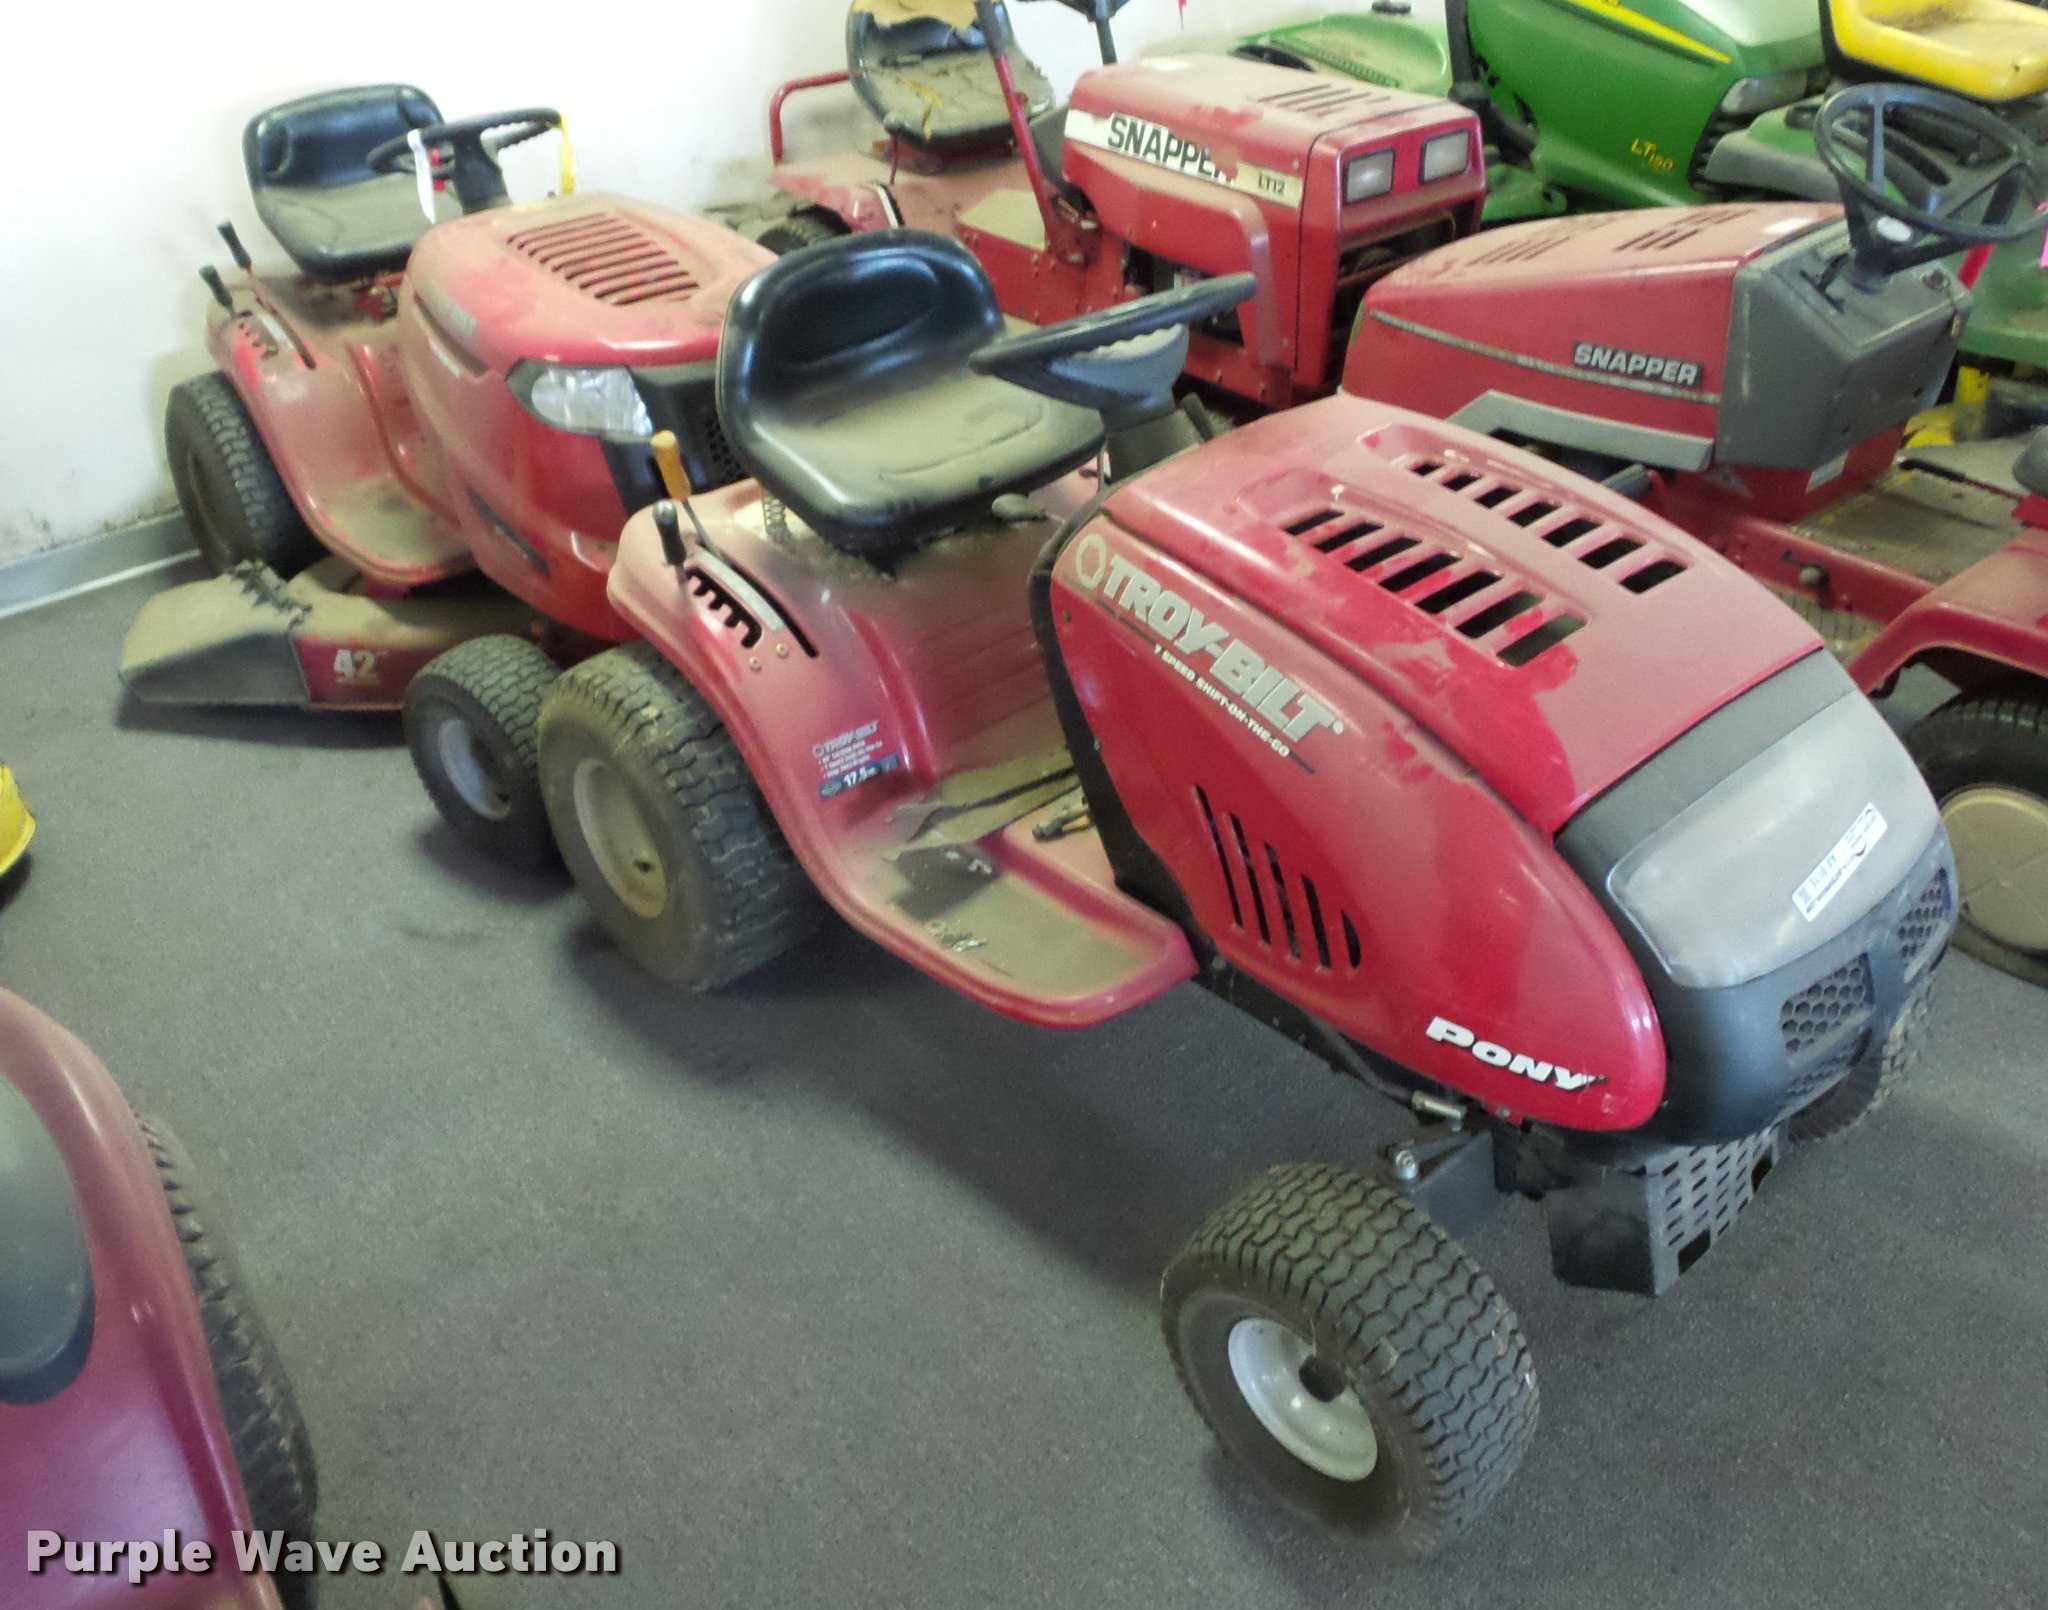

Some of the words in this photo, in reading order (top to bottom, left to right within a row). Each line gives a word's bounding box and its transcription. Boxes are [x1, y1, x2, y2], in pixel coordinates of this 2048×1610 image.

[1258, 171, 1287, 196] LT12
[1573, 342, 1699, 386] SNAPPER
[1103, 553, 1336, 743] TROY-BILT
[1161, 649, 1197, 682] SPEED
[1425, 1015, 1597, 1091] PONY
